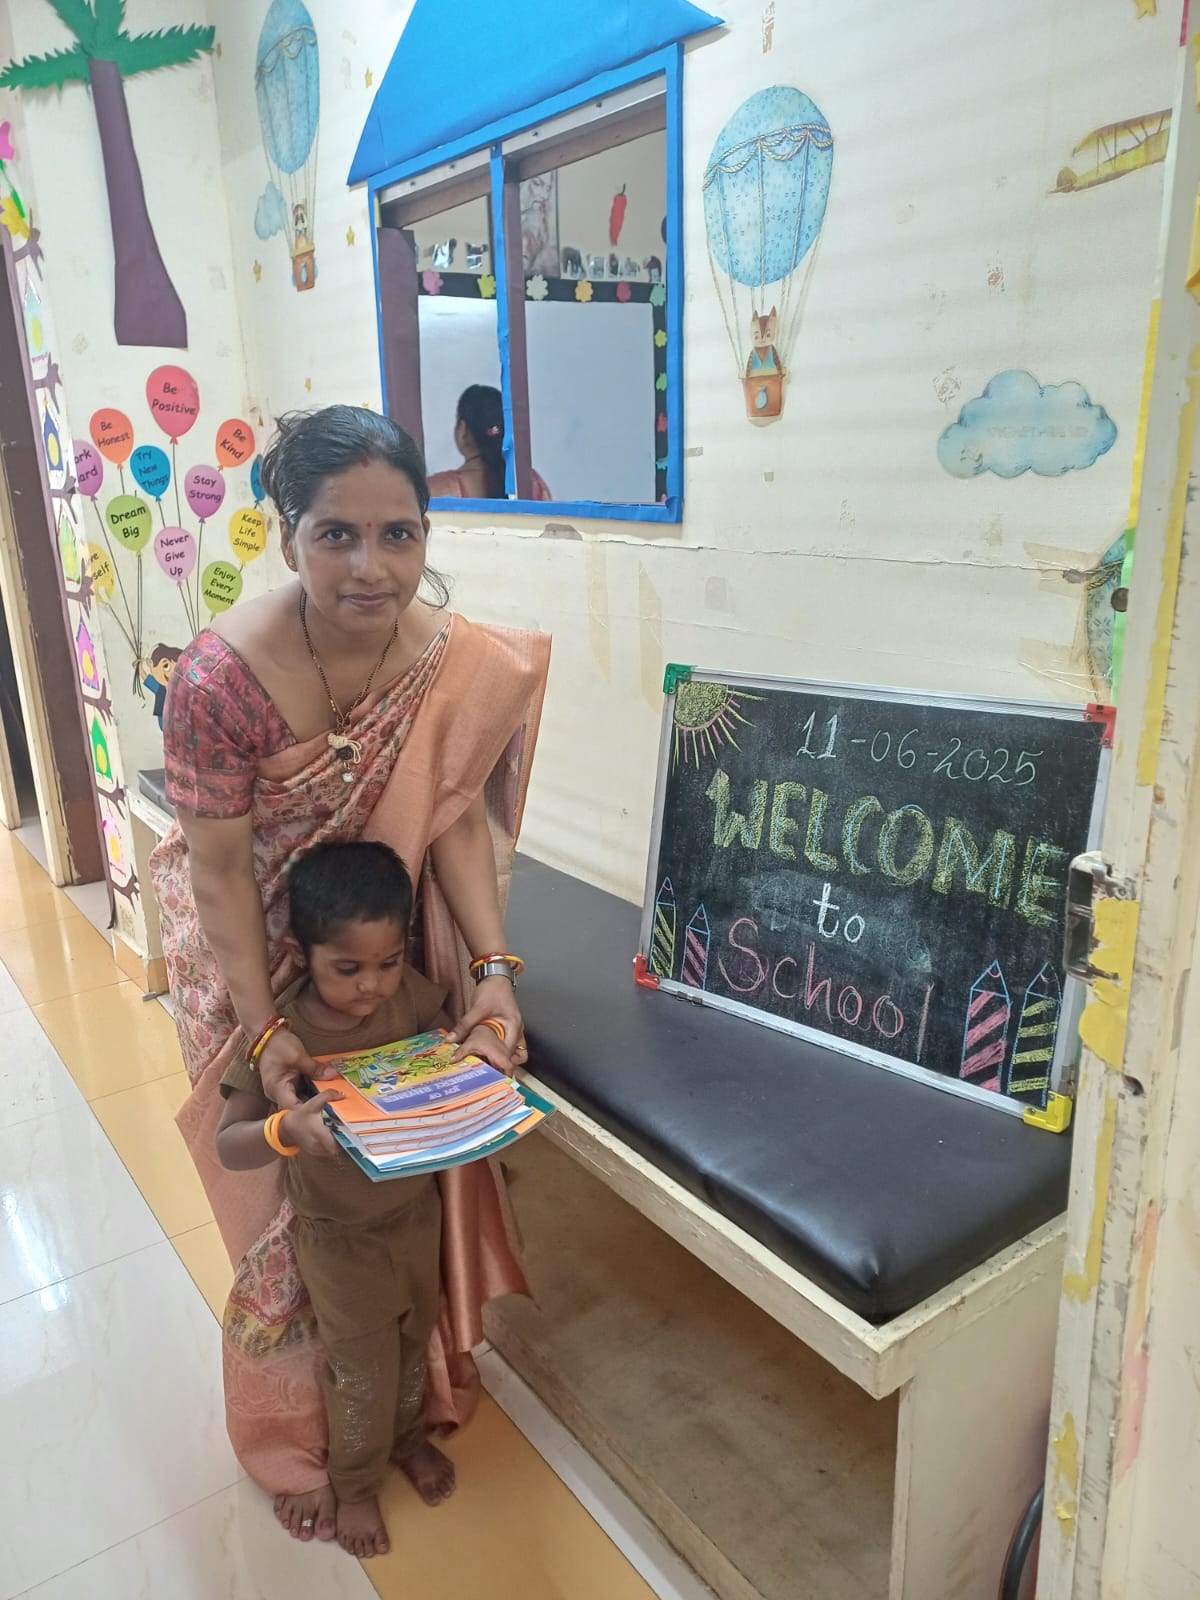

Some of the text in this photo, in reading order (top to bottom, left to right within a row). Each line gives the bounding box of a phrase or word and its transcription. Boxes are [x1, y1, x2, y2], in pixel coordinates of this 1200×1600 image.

[163, 382, 177, 395] Be
[152, 398, 197, 416] Positive
[100, 421, 113, 431] Be
[97, 432, 131, 448] Honest
[232, 428, 247, 442] Be
[74, 449, 93, 464] ork
[135, 451, 152, 461] Try
[219, 438, 245, 460] Kind
[77, 465, 99, 483] ard
[138, 464, 158, 477] New
[142, 474, 169, 489] Things
[193, 475, 217, 488] Stay
[189, 489, 222, 503] Strong
[110, 506, 146, 524] Dream
[241, 513, 262, 527] Keep
[122, 525, 140, 538] Big
[238, 525, 257, 538] Life
[160, 534, 189, 548] Never
[232, 537, 261, 552] Simple
[164, 551, 185, 562] Give
[169, 566, 183, 577] Up
[213, 567, 237, 582] Enjoy
[210, 578, 234, 593] Every
[203, 589, 235, 605] Moment
[796, 711, 1044, 786] 11-06-2025
[705, 768, 1070, 928] WELCOME
[813, 882, 866, 943] to
[718, 917, 935, 1063] School
[383, 1069, 487, 1103] NURSERY RHYMES
[429, 1085, 461, 1100] JOY OF
